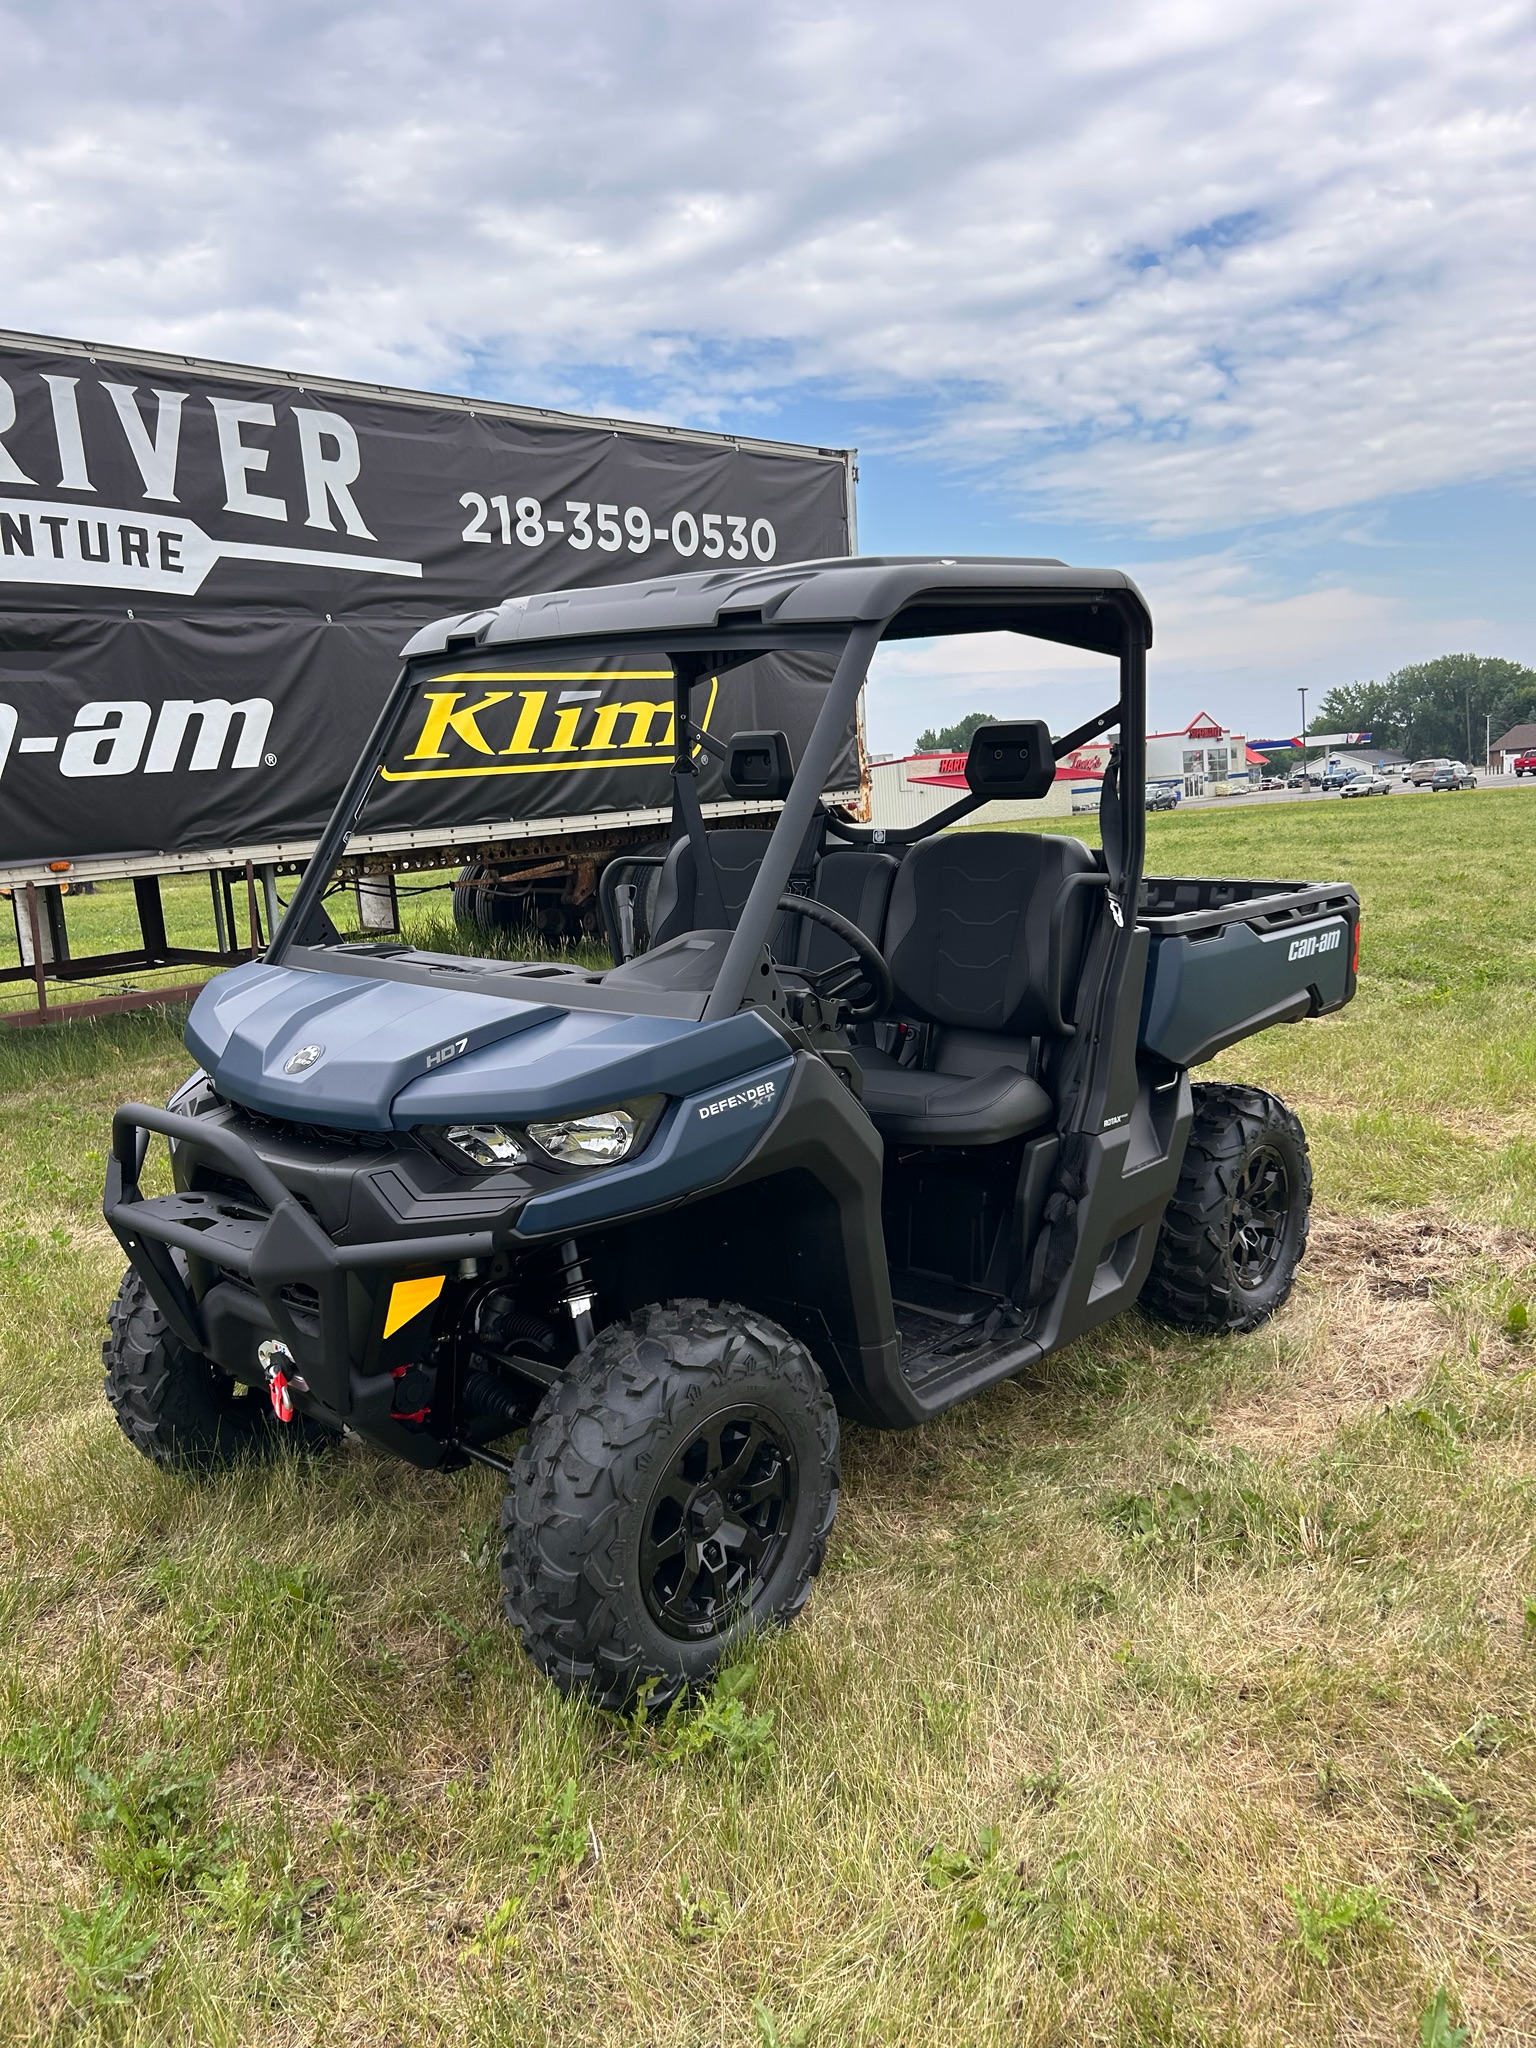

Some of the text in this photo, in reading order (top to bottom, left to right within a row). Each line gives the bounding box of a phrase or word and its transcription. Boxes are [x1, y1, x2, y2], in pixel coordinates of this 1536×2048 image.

[459, 492, 776, 561] 218-359-0530
[404, 690, 674, 760] Klim
[1288, 929, 1341, 961] can-am
[426, 1037, 468, 1069] HD7
[698, 1081, 775, 1120] DEFENDER
[750, 1092, 775, 1109] XT
[1103, 1115, 1122, 1128] ROTAX
